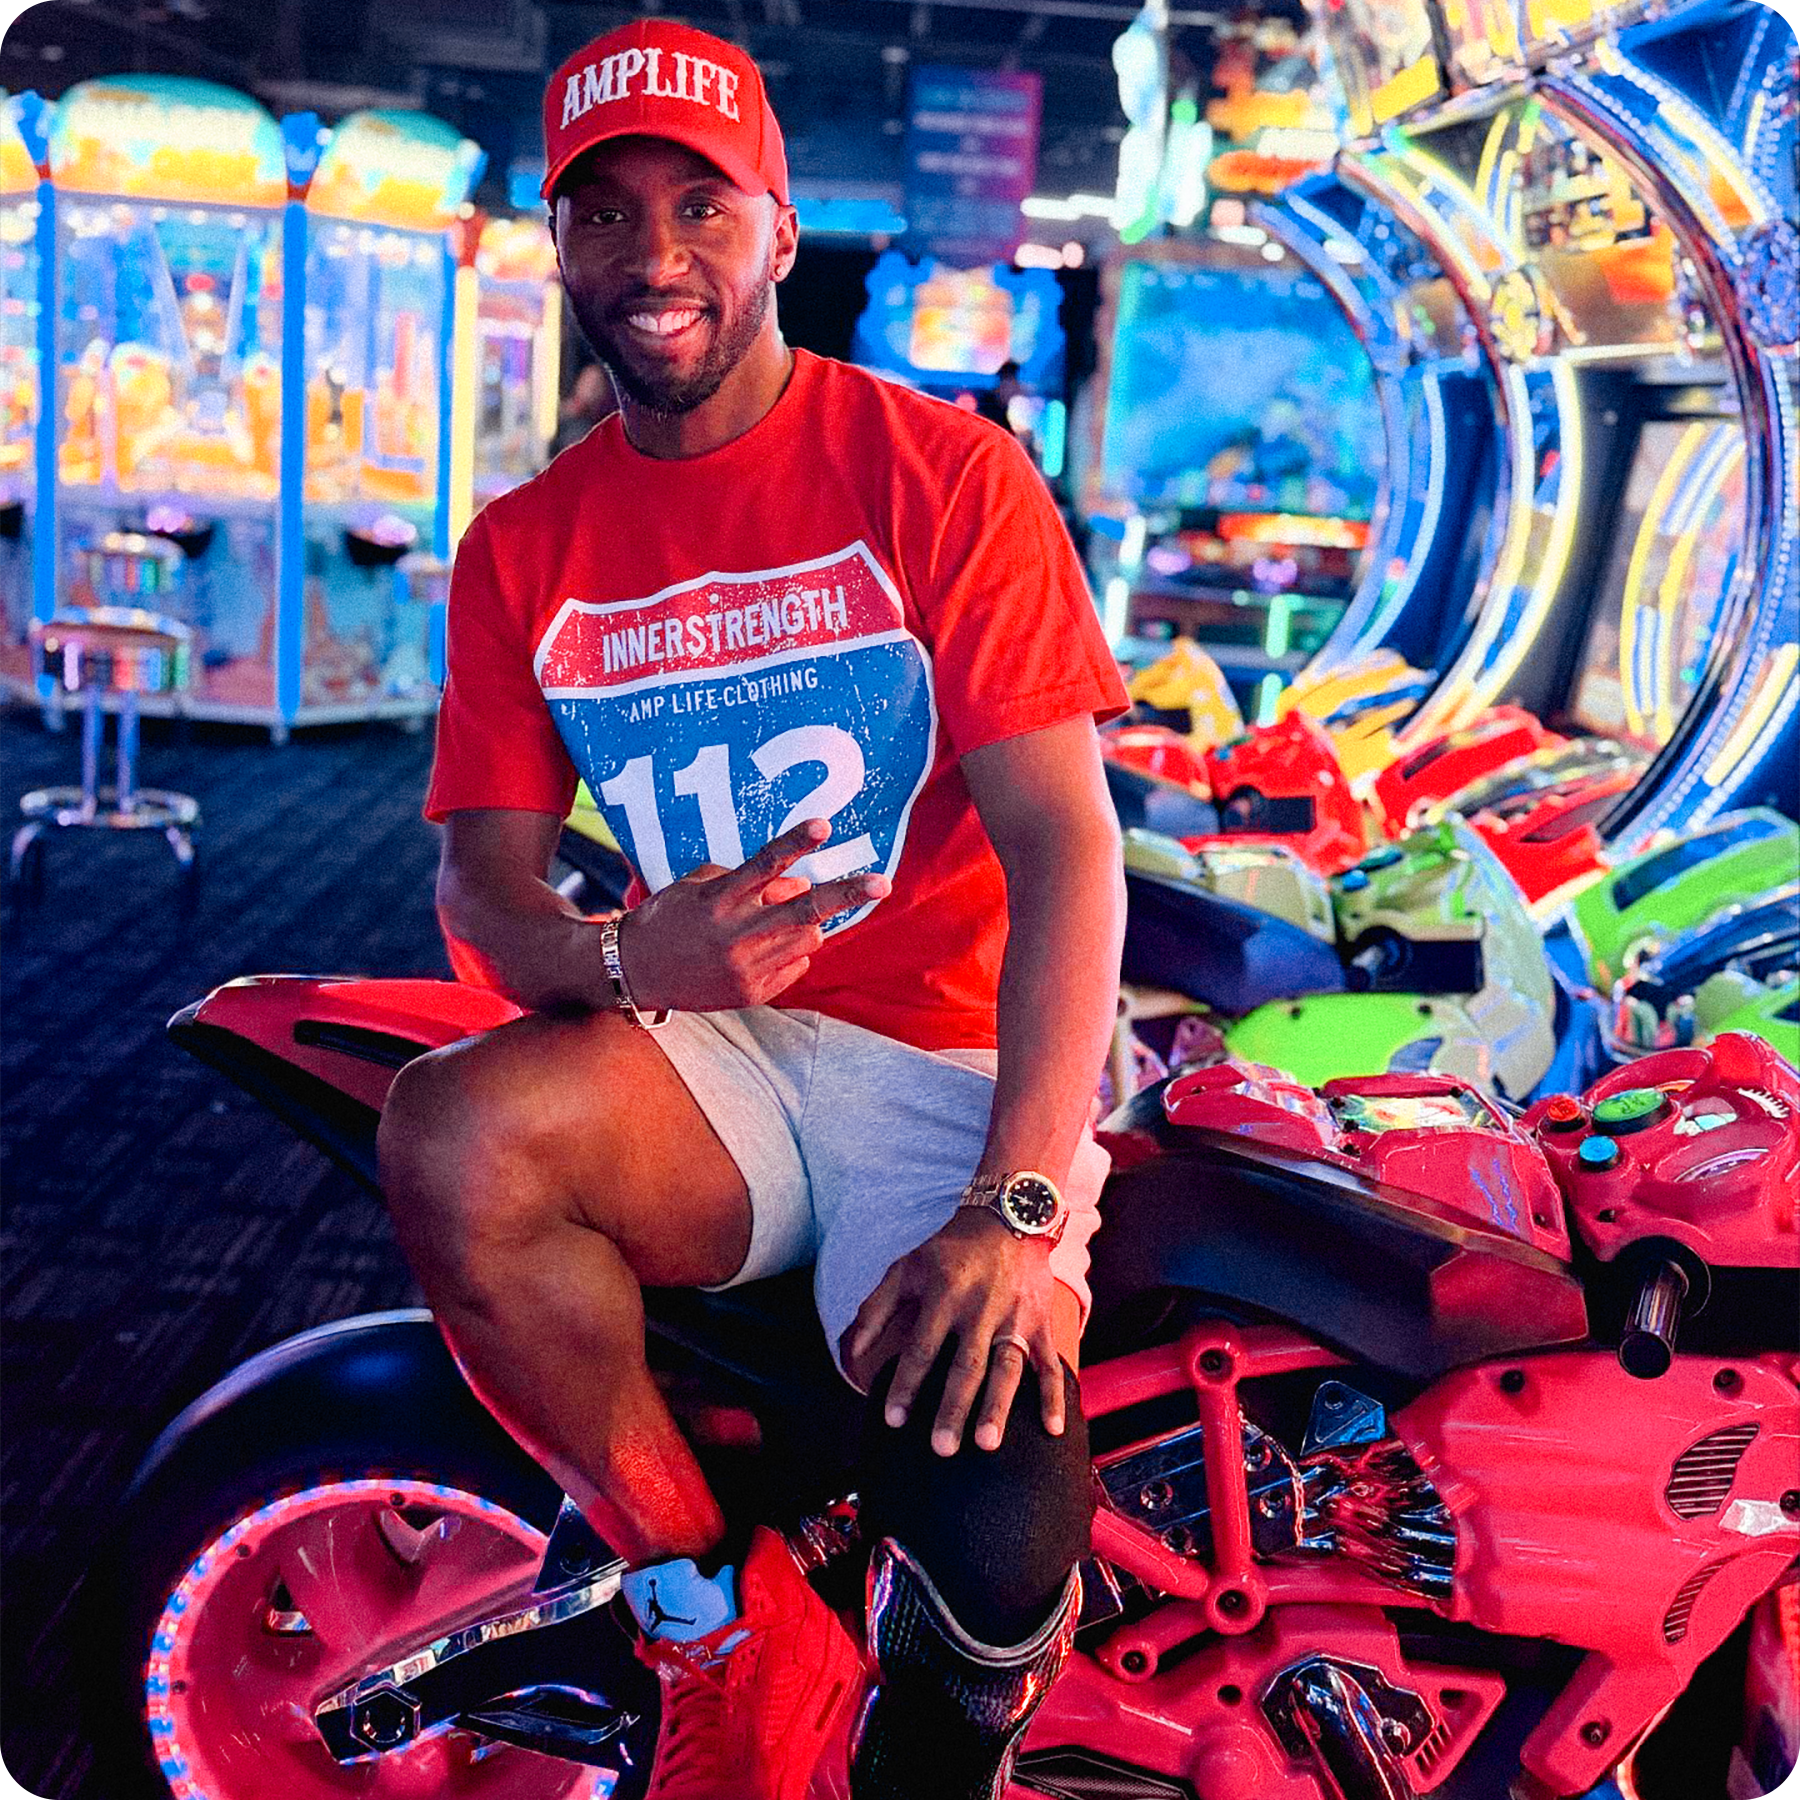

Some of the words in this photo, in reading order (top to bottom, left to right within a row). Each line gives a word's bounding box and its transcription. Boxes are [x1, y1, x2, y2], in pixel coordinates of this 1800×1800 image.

[561, 47, 740, 130] AMPLIFE
[602, 585, 848, 673] INNERSTRENGTH
[629, 696, 665, 722] AMP
[600, 724, 880, 894] 112
